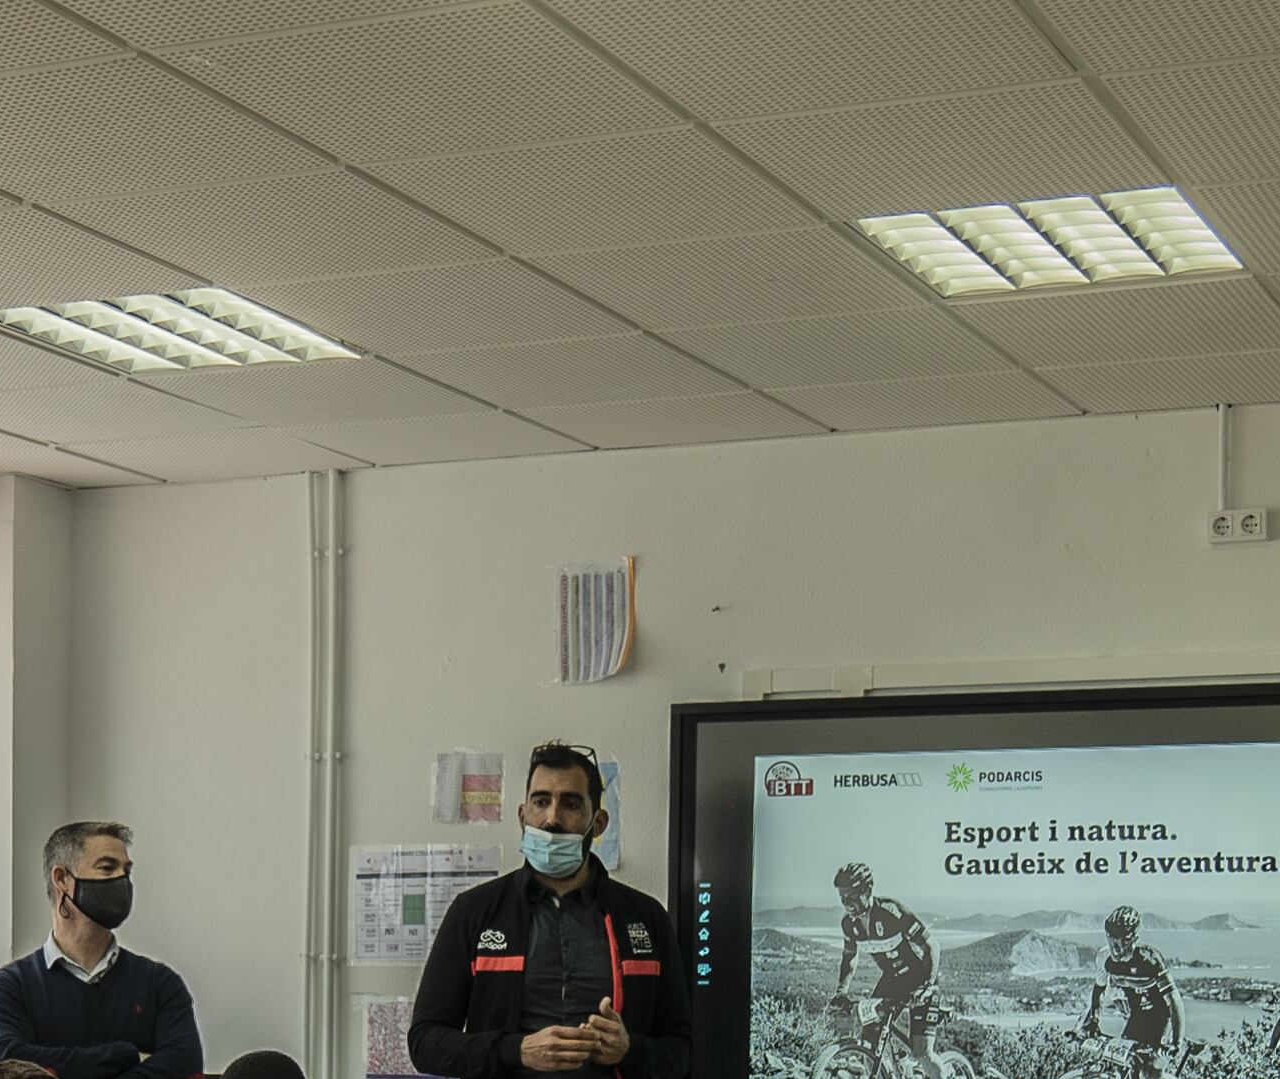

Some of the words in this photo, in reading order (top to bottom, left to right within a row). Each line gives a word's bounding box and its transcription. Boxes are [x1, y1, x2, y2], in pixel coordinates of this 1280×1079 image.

[833, 774, 898, 788] HERBUSA
[979, 770, 1043, 783] PODARCIS
[774, 780, 812, 796] BTT
[944, 820, 1040, 848] Esport
[1049, 819, 1059, 842] i
[1067, 819, 1178, 842] natura.
[944, 851, 1066, 876] Gaudeix
[1075, 851, 1110, 874] de
